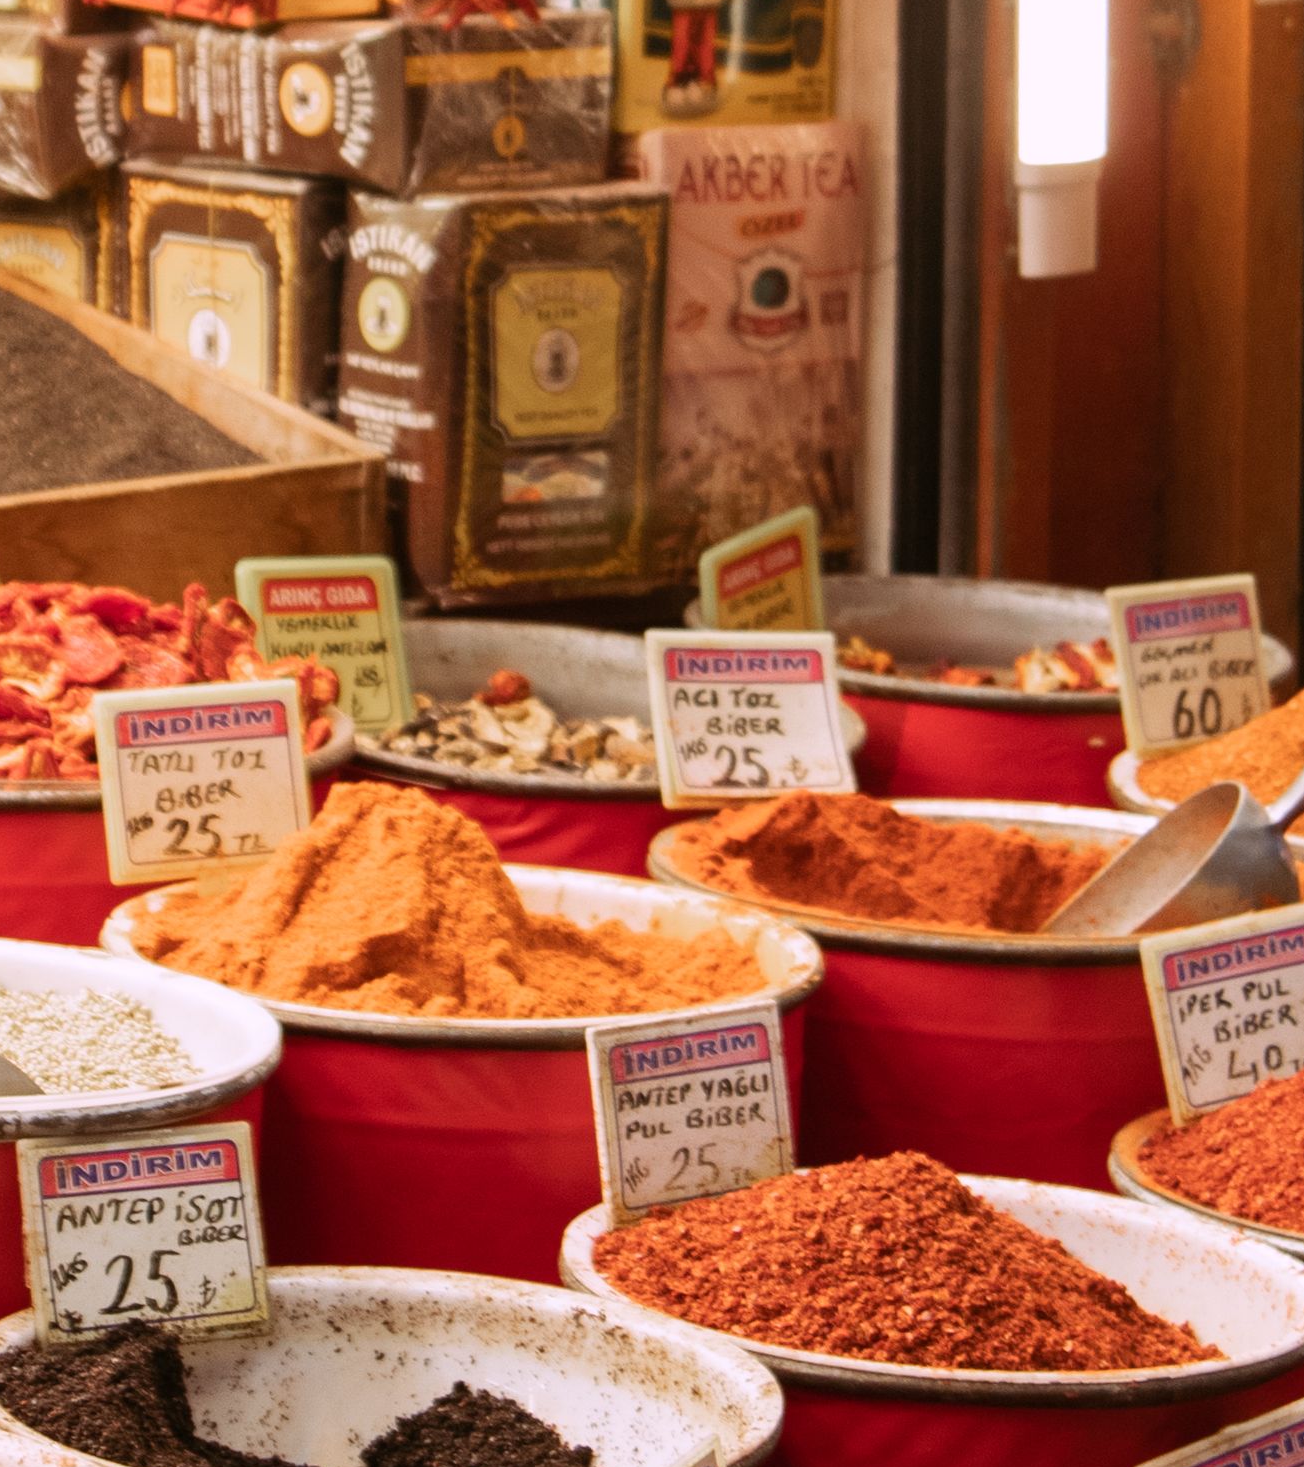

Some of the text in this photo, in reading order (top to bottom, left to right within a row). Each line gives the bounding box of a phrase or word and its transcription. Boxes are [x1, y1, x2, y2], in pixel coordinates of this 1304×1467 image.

[270, 585, 370, 609] ARINÇ GIDA
[676, 653, 810, 676] İNDİRİM
[674, 687, 781, 711] ACI TOZ
[129, 706, 274, 744] İNDİRİM
[162, 813, 223, 858] 25
[1242, 978, 1290, 1003] PUL
[621, 1032, 757, 1077] İNDİRİM
[1226, 1044, 1284, 1085] 40
[617, 1069, 771, 1114] ANTEP YAĞLI
[625, 1119, 673, 1142] PUL
[53, 1147, 224, 1192] İNDİRİM
[662, 1141, 721, 1193] 25
[55, 1195, 167, 1234] ANTEP
[97, 1248, 181, 1316] 25
